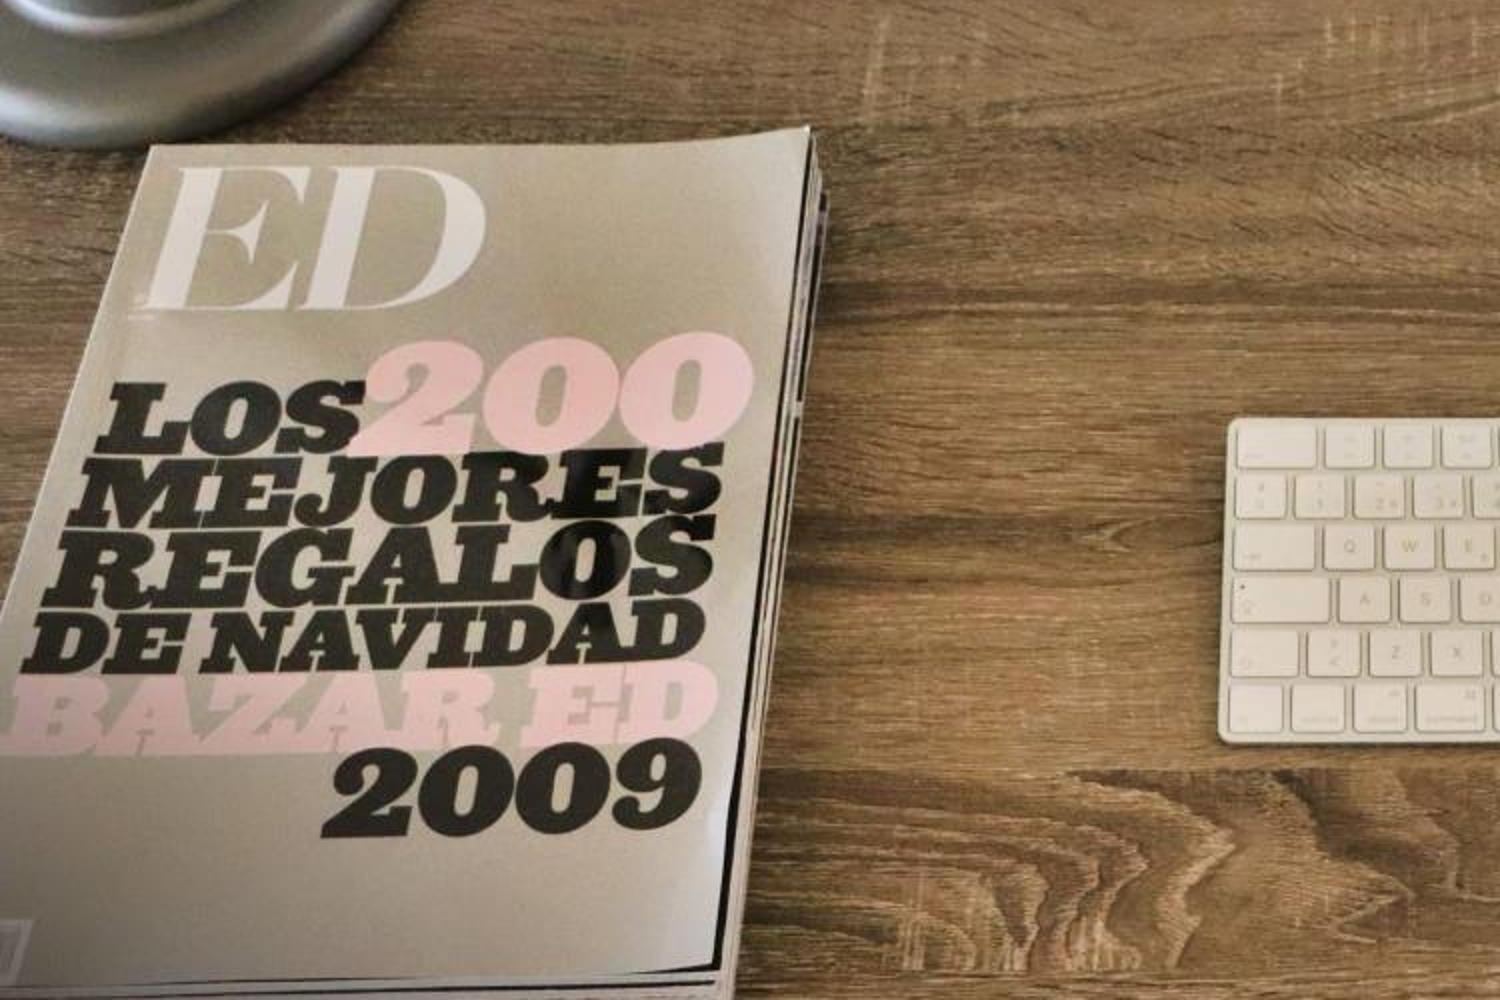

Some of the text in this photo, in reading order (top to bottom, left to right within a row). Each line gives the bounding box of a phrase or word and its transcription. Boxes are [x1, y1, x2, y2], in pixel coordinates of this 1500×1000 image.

[141, 165, 487, 310] ED
[94, 332, 754, 455] LOS 200
[66, 443, 723, 528] MEJORES
[41, 514, 716, 610] REGALOS
[20, 600, 706, 675] DE NAVIDAD
[0, 661, 719, 758] BAZAR ED
[320, 739, 703, 839] 2009
